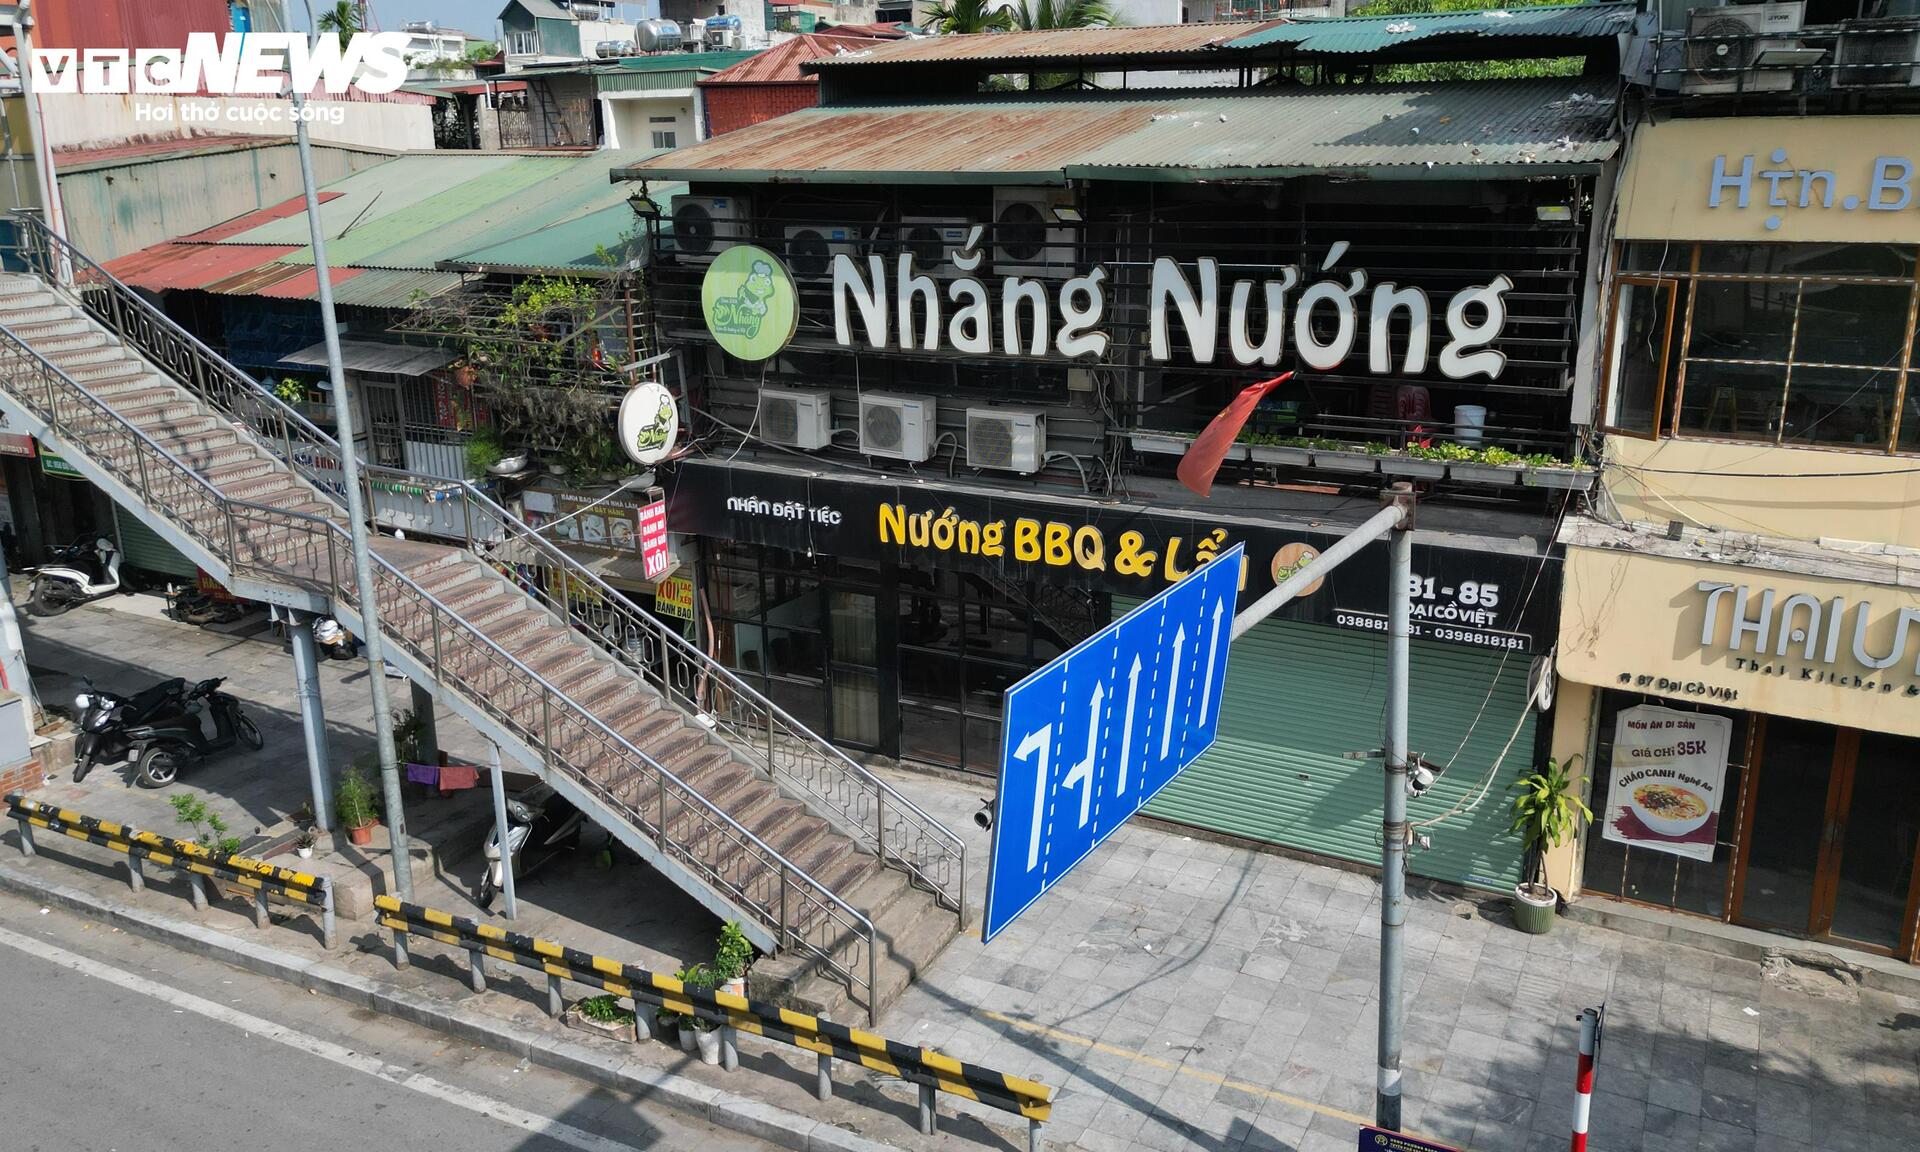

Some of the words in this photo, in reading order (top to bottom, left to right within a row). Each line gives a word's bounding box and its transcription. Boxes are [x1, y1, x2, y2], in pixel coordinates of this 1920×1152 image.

[833, 224, 1111, 358] Nhắng
[1150, 240, 1515, 381] Nướng
[727, 496, 770, 516] NHẬN
[772, 500, 806, 521] ĐẶT
[808, 505, 843, 527] TIỆC
[878, 502, 1007, 557] Nướng
[1014, 517, 1105, 572] BBQ
[1113, 530, 1157, 578] &
[647, 548, 668, 577] XÔI
[657, 576, 676, 601] XÔI
[1458, 580, 1500, 608] 85
[656, 599, 677, 616] BÁNH
[677, 605, 693, 619] BAO
[1434, 600, 1459, 620] CỒ
[1459, 607, 1499, 629] VIỆT
[1434, 627, 1525, 651] 0398818181
[1638, 674, 1655, 686] 87
[1659, 677, 1682, 693] Đại
[1709, 686, 1738, 701] Việt
[1736, 657, 1785, 677] Thai
[1801, 667, 1893, 693] Kitchen
[1627, 719, 1648, 730] MÓN
[1665, 720, 1675, 728] DI
[1677, 717, 1696, 730] SẢN
[1677, 740, 1707, 756] 35K
[1618, 770, 1645, 788] CHÁO
[1645, 769, 1676, 778] CANH
[1678, 773, 1701, 787] Nghệ
[1701, 782, 1714, 792] An
